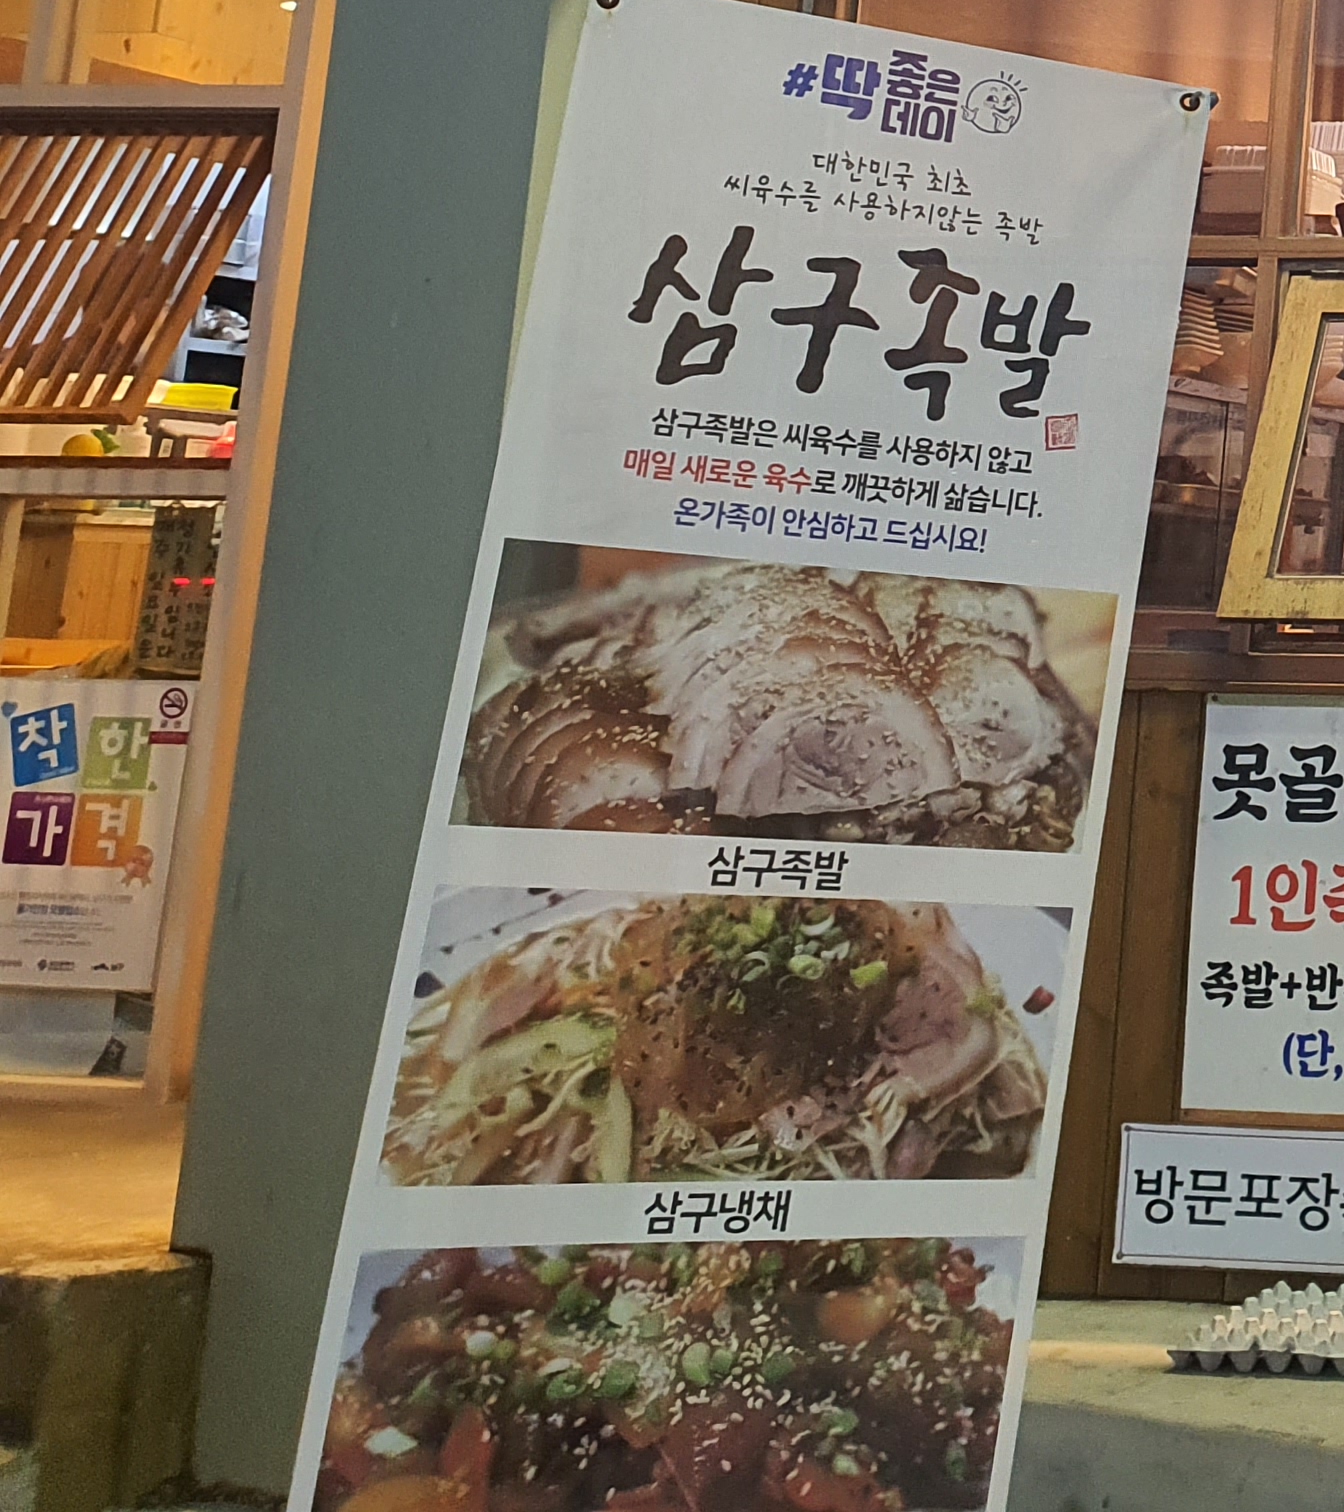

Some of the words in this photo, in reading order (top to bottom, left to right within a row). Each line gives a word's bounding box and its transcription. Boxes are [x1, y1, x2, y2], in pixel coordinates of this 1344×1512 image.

[887, 48, 963, 107] 좋은
[879, 96, 958, 144] 데이
[811, 150, 914, 191] 대한민국
[924, 162, 972, 199] 최초
[723, 172, 823, 215] 씨육수를
[832, 190, 984, 237] 사용하지않는
[993, 210, 1045, 248] 족발
[627, 224, 1093, 423] 삼구족발
[650, 406, 779, 451] 삼구족발은
[782, 421, 884, 462] 씨육수를
[885, 433, 983, 474] 사용하지
[986, 445, 1034, 476] 않고
[623, 446, 677, 483] 매일
[679, 451, 759, 490] 새로운
[762, 462, 837, 497] 육수로
[840, 471, 940, 511] 깨끗하게
[942, 481, 1044, 520] 삶습니다.
[672, 495, 776, 537] 온가족이
[781, 506, 878, 544] 안심하고
[881, 516, 989, 556] 드십시요!
[18, 708, 150, 781] 착한
[15, 797, 130, 862] 가격
[706, 844, 851, 892] 삼구족발
[643, 1189, 793, 1236] 삼구냉채
